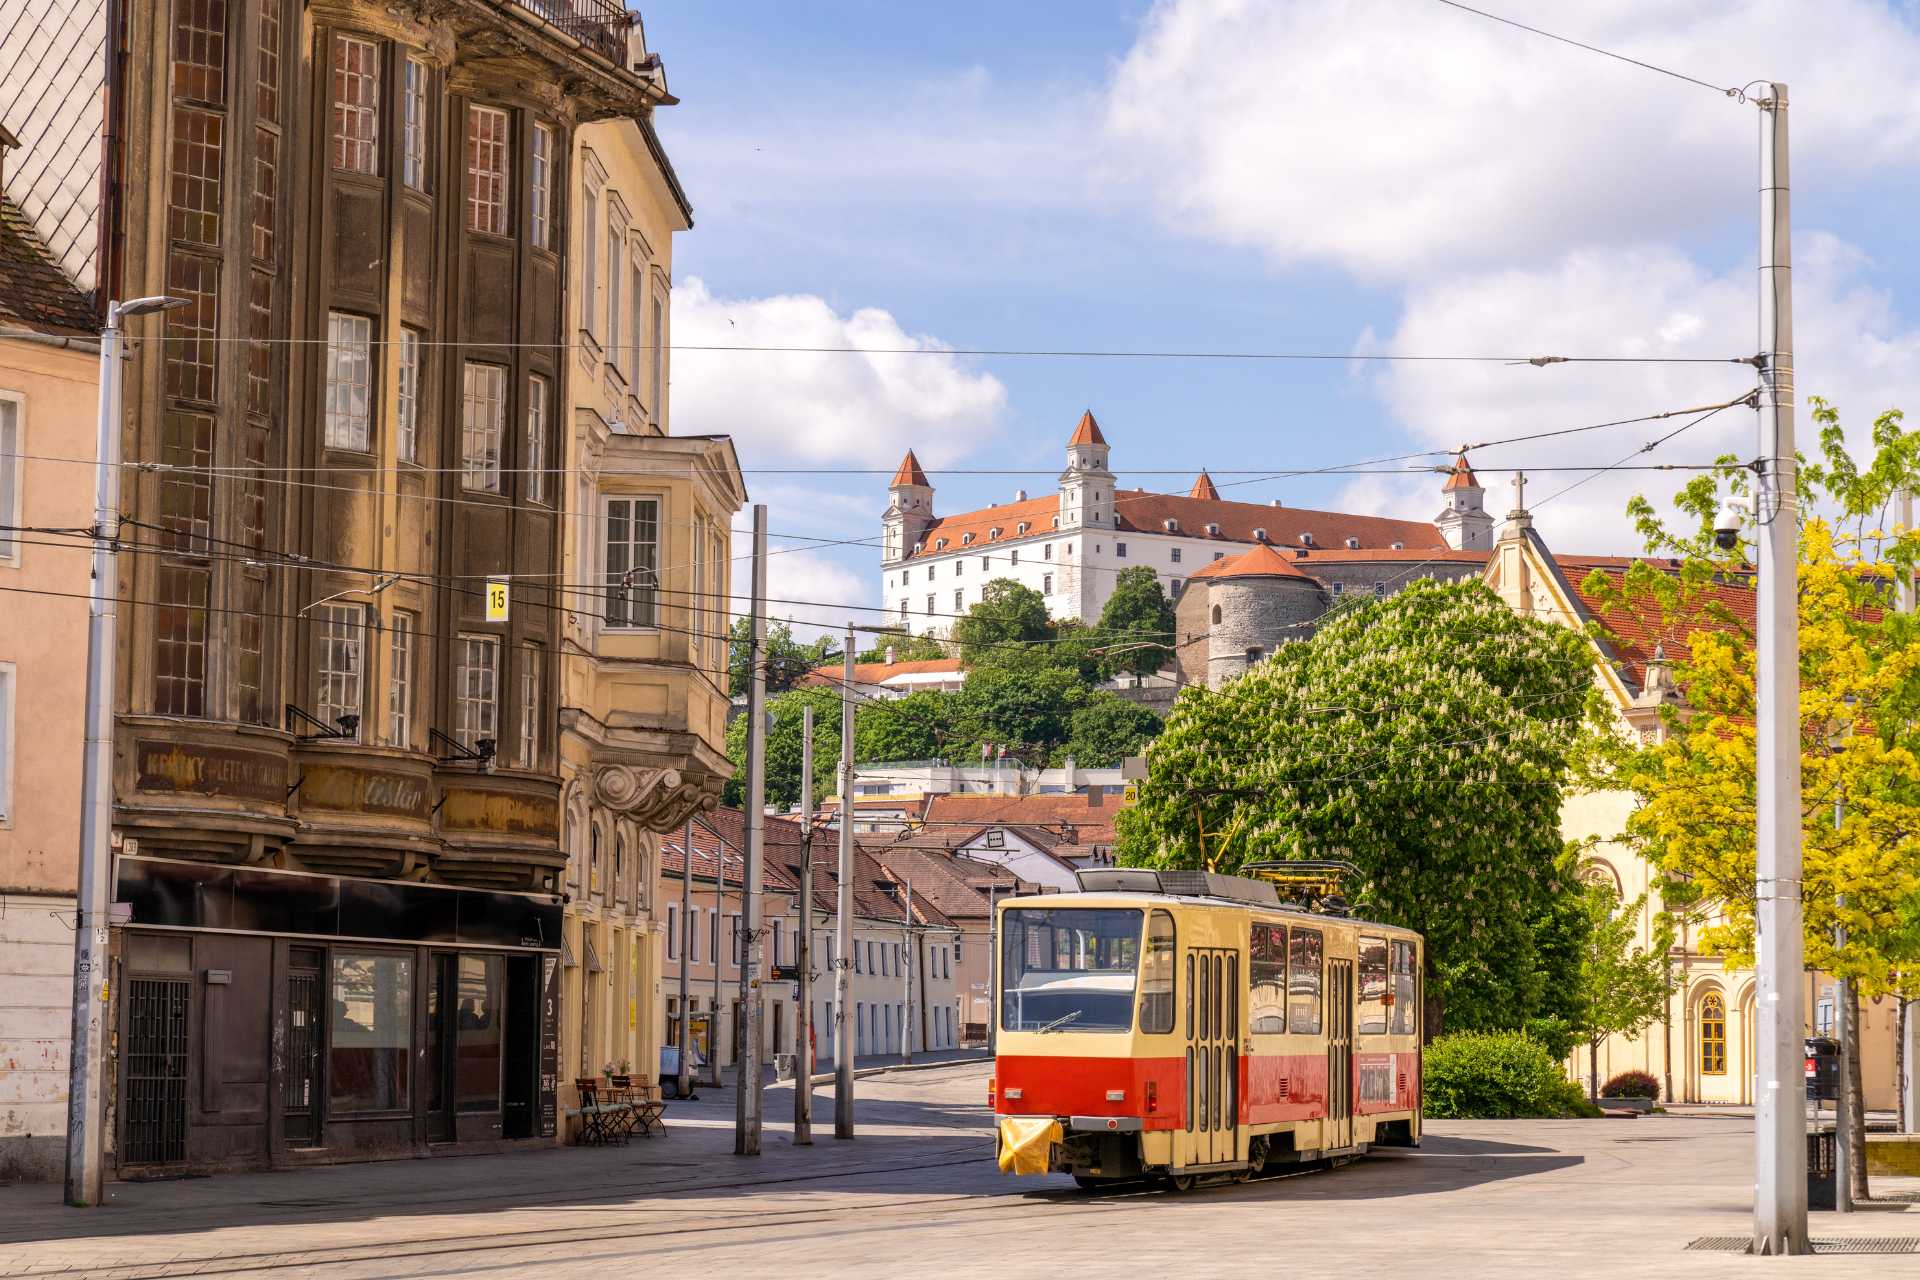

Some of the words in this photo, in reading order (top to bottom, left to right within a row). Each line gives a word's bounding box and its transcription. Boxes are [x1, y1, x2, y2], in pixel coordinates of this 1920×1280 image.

[491, 591, 504, 608] 15
[1125, 791, 1136, 801] 20
[547, 999, 553, 1016] 3
